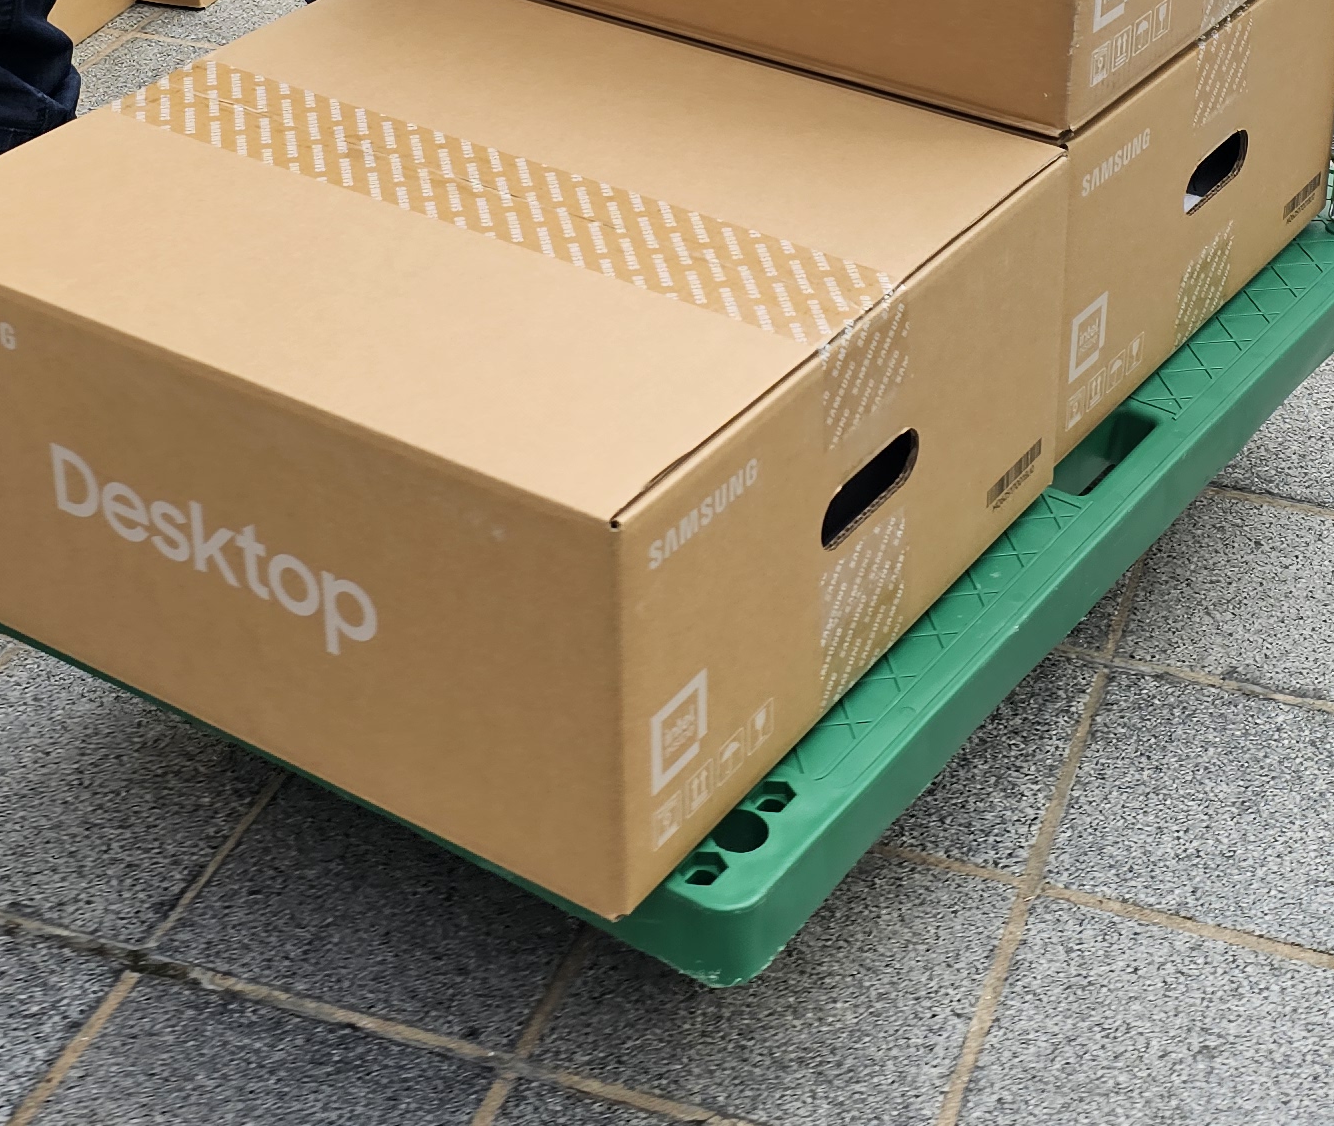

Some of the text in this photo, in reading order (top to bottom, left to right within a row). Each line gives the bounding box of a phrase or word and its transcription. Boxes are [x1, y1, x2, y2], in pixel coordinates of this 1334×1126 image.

[1081, 127, 1152, 196] SAMSUNG
[49, 443, 378, 654] Desktop
[648, 457, 758, 569] SAMSUNG
